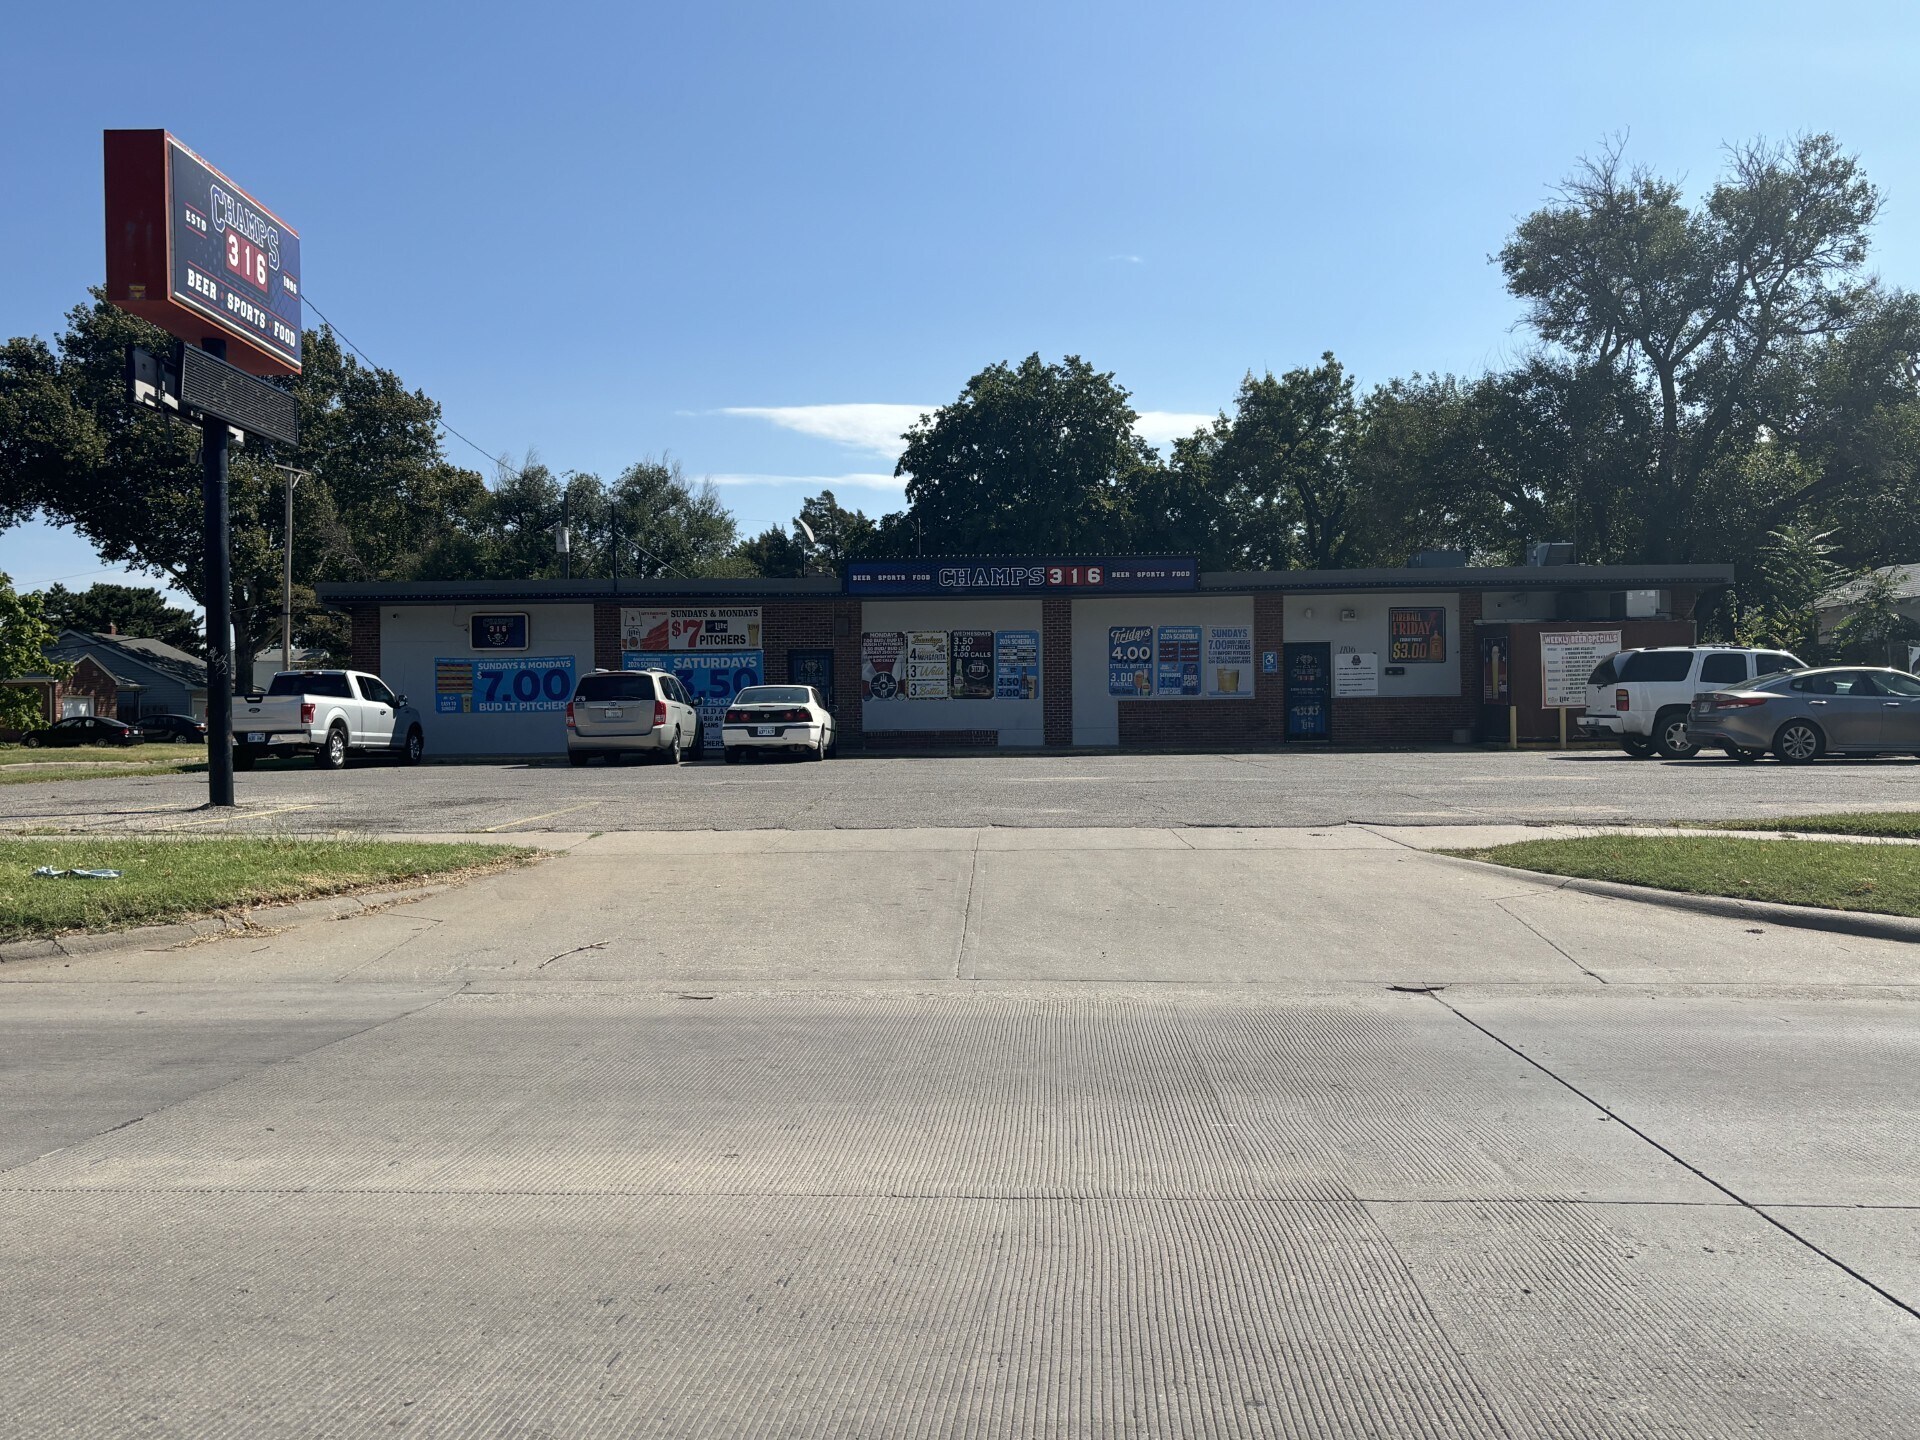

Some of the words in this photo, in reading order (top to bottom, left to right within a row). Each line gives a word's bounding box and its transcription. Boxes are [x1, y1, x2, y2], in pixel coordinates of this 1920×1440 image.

[185, 209, 207, 232] ESTD
[210, 184, 280, 271] CHAMPS
[228, 234, 266, 285] 316
[187, 268, 217, 301] BEER
[227, 292, 266, 329] SPORTS
[273, 321, 296, 348] FOOD
[938, 567, 1045, 587] CHAMPS
[1049, 568, 1102, 584] 316
[671, 610, 706, 618] SUNDAYS
[719, 609, 759, 617] MONDAYS
[1392, 612, 1421, 621] FIREBALL
[671, 620, 703, 648] $7
[1211, 629, 1248, 638] SUNDAYS
[1392, 621, 1432, 635] FRIDAY
[700, 635, 746, 645] PITCHERS
[953, 637, 974, 645] 3.50
[1110, 628, 1151, 645] Fridays
[1545, 635, 1570, 644] WEEKLY
[1570, 635, 1588, 643] BEER
[1588, 633, 1619, 643] SPECIALS
[909, 648, 917, 660] 4
[1111, 646, 1151, 660] 4.00
[1392, 641, 1427, 660] $3.00
[478, 662, 518, 670] SUNDAYS
[520, 661, 526, 669] &
[528, 660, 571, 669] MONDAYS
[674, 656, 758, 669] SATURDAYS
[910, 665, 917, 678] 3
[1110, 673, 1133, 682] 3.00
[910, 683, 917, 696] 3
[480, 702, 503, 711] BUD
[505, 702, 518, 711] LT
